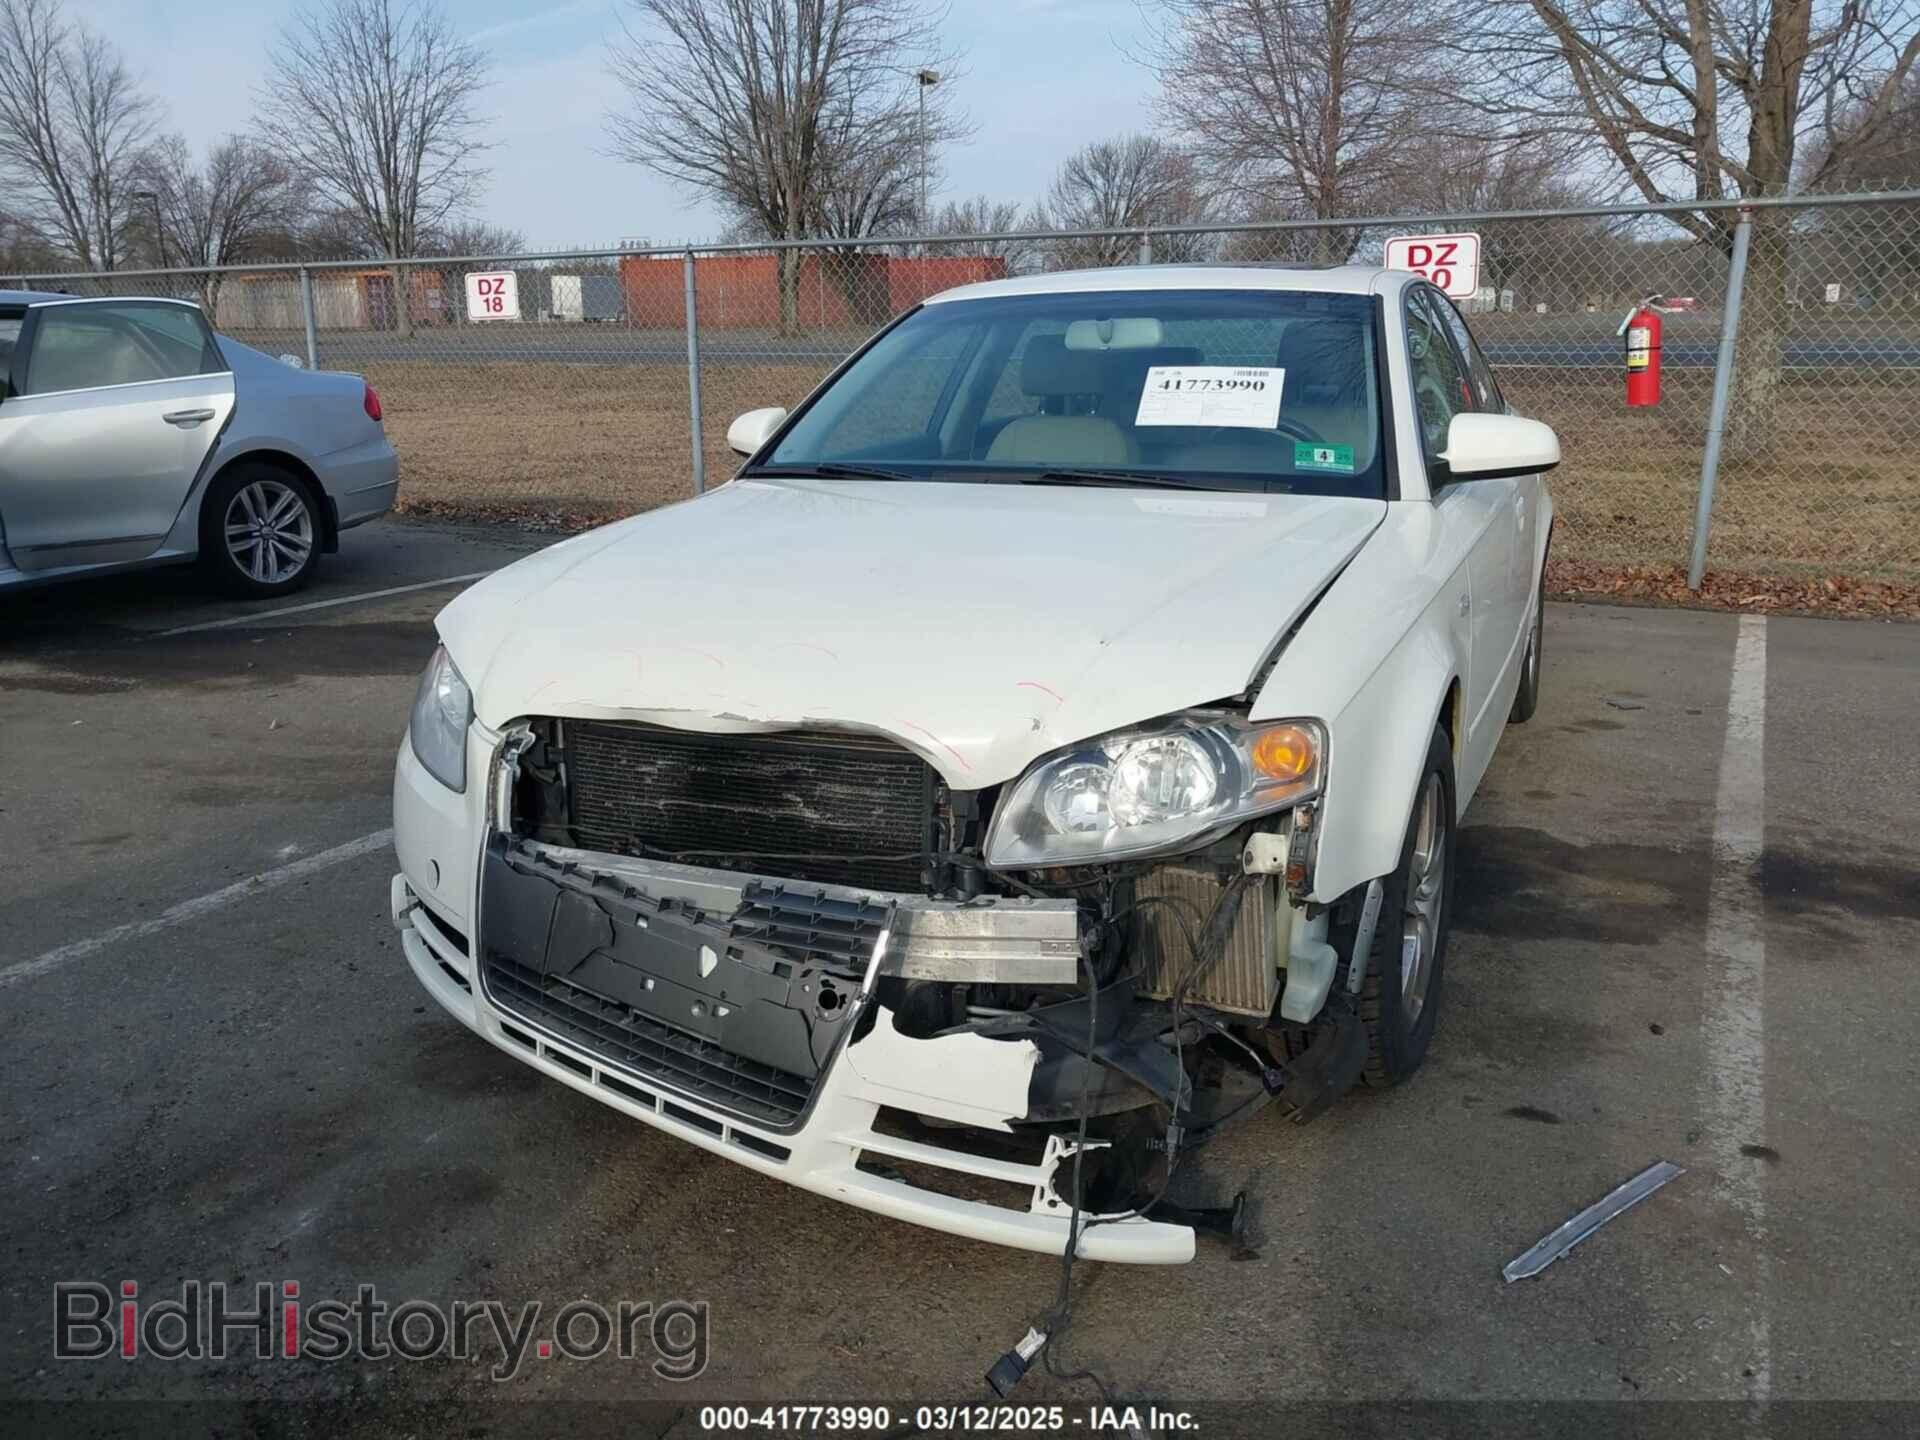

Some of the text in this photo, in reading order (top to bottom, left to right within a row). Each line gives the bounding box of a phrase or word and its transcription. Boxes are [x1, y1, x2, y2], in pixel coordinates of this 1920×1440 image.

[1407, 243, 1458, 268] DZ
[478, 278, 506, 296] DZ
[1410, 268, 1452, 290] 0
[483, 296, 504, 313] 18
[1158, 379, 1266, 392] 41773990
[1319, 450, 1329, 461] 4
